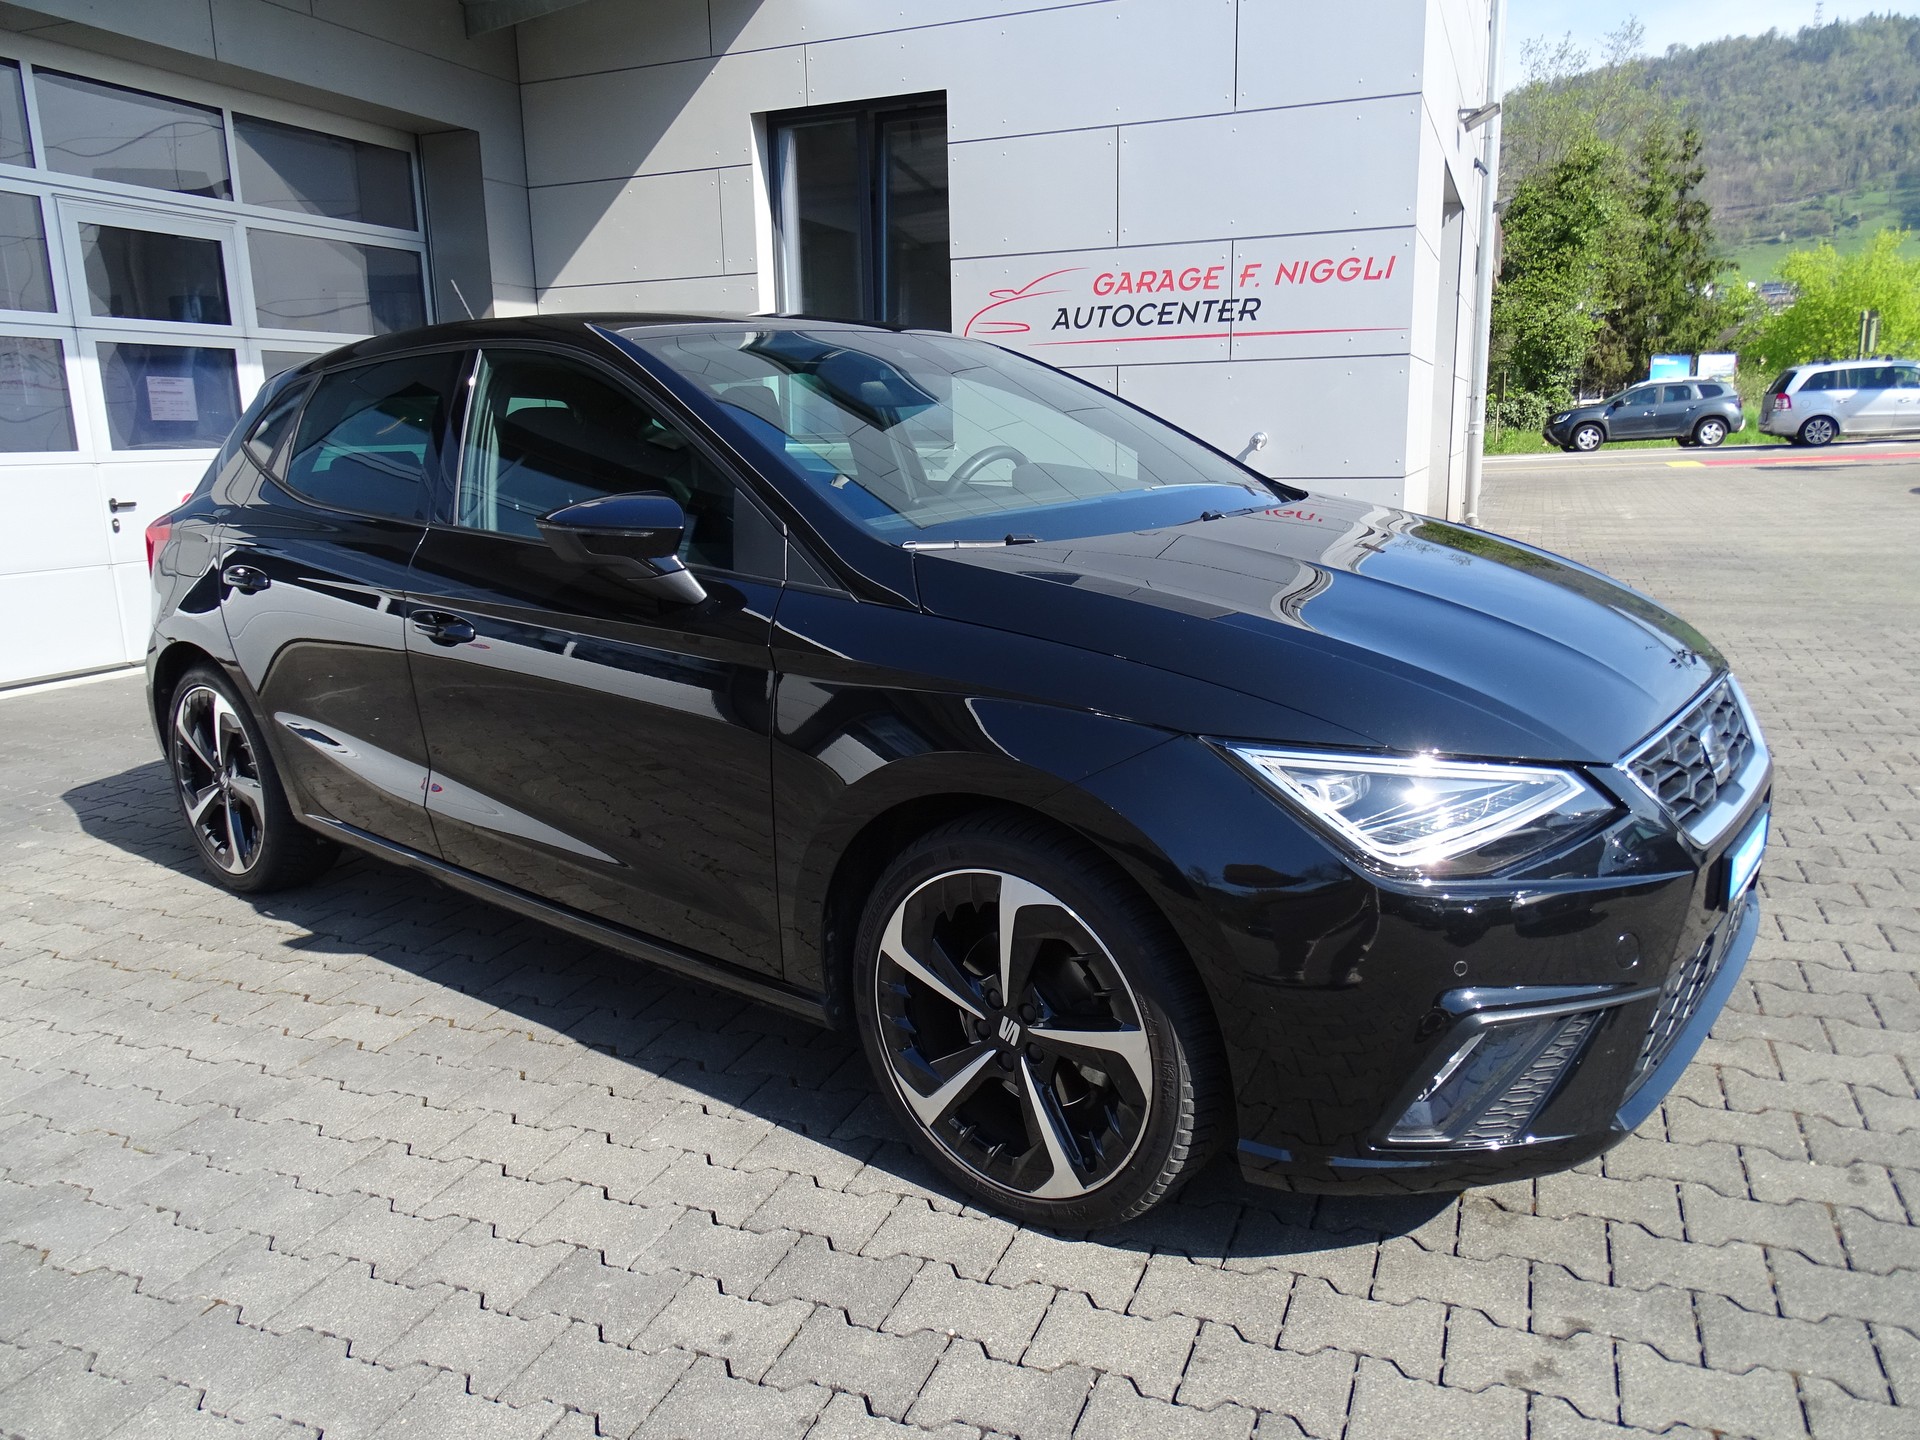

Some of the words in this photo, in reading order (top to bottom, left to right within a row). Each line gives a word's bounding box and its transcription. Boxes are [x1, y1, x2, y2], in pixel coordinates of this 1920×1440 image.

[1092, 265, 1225, 297] GARAGE
[1239, 263, 1262, 288] F.
[1275, 256, 1397, 286] NIGGLI
[1051, 298, 1262, 331] AUTOCENTER
